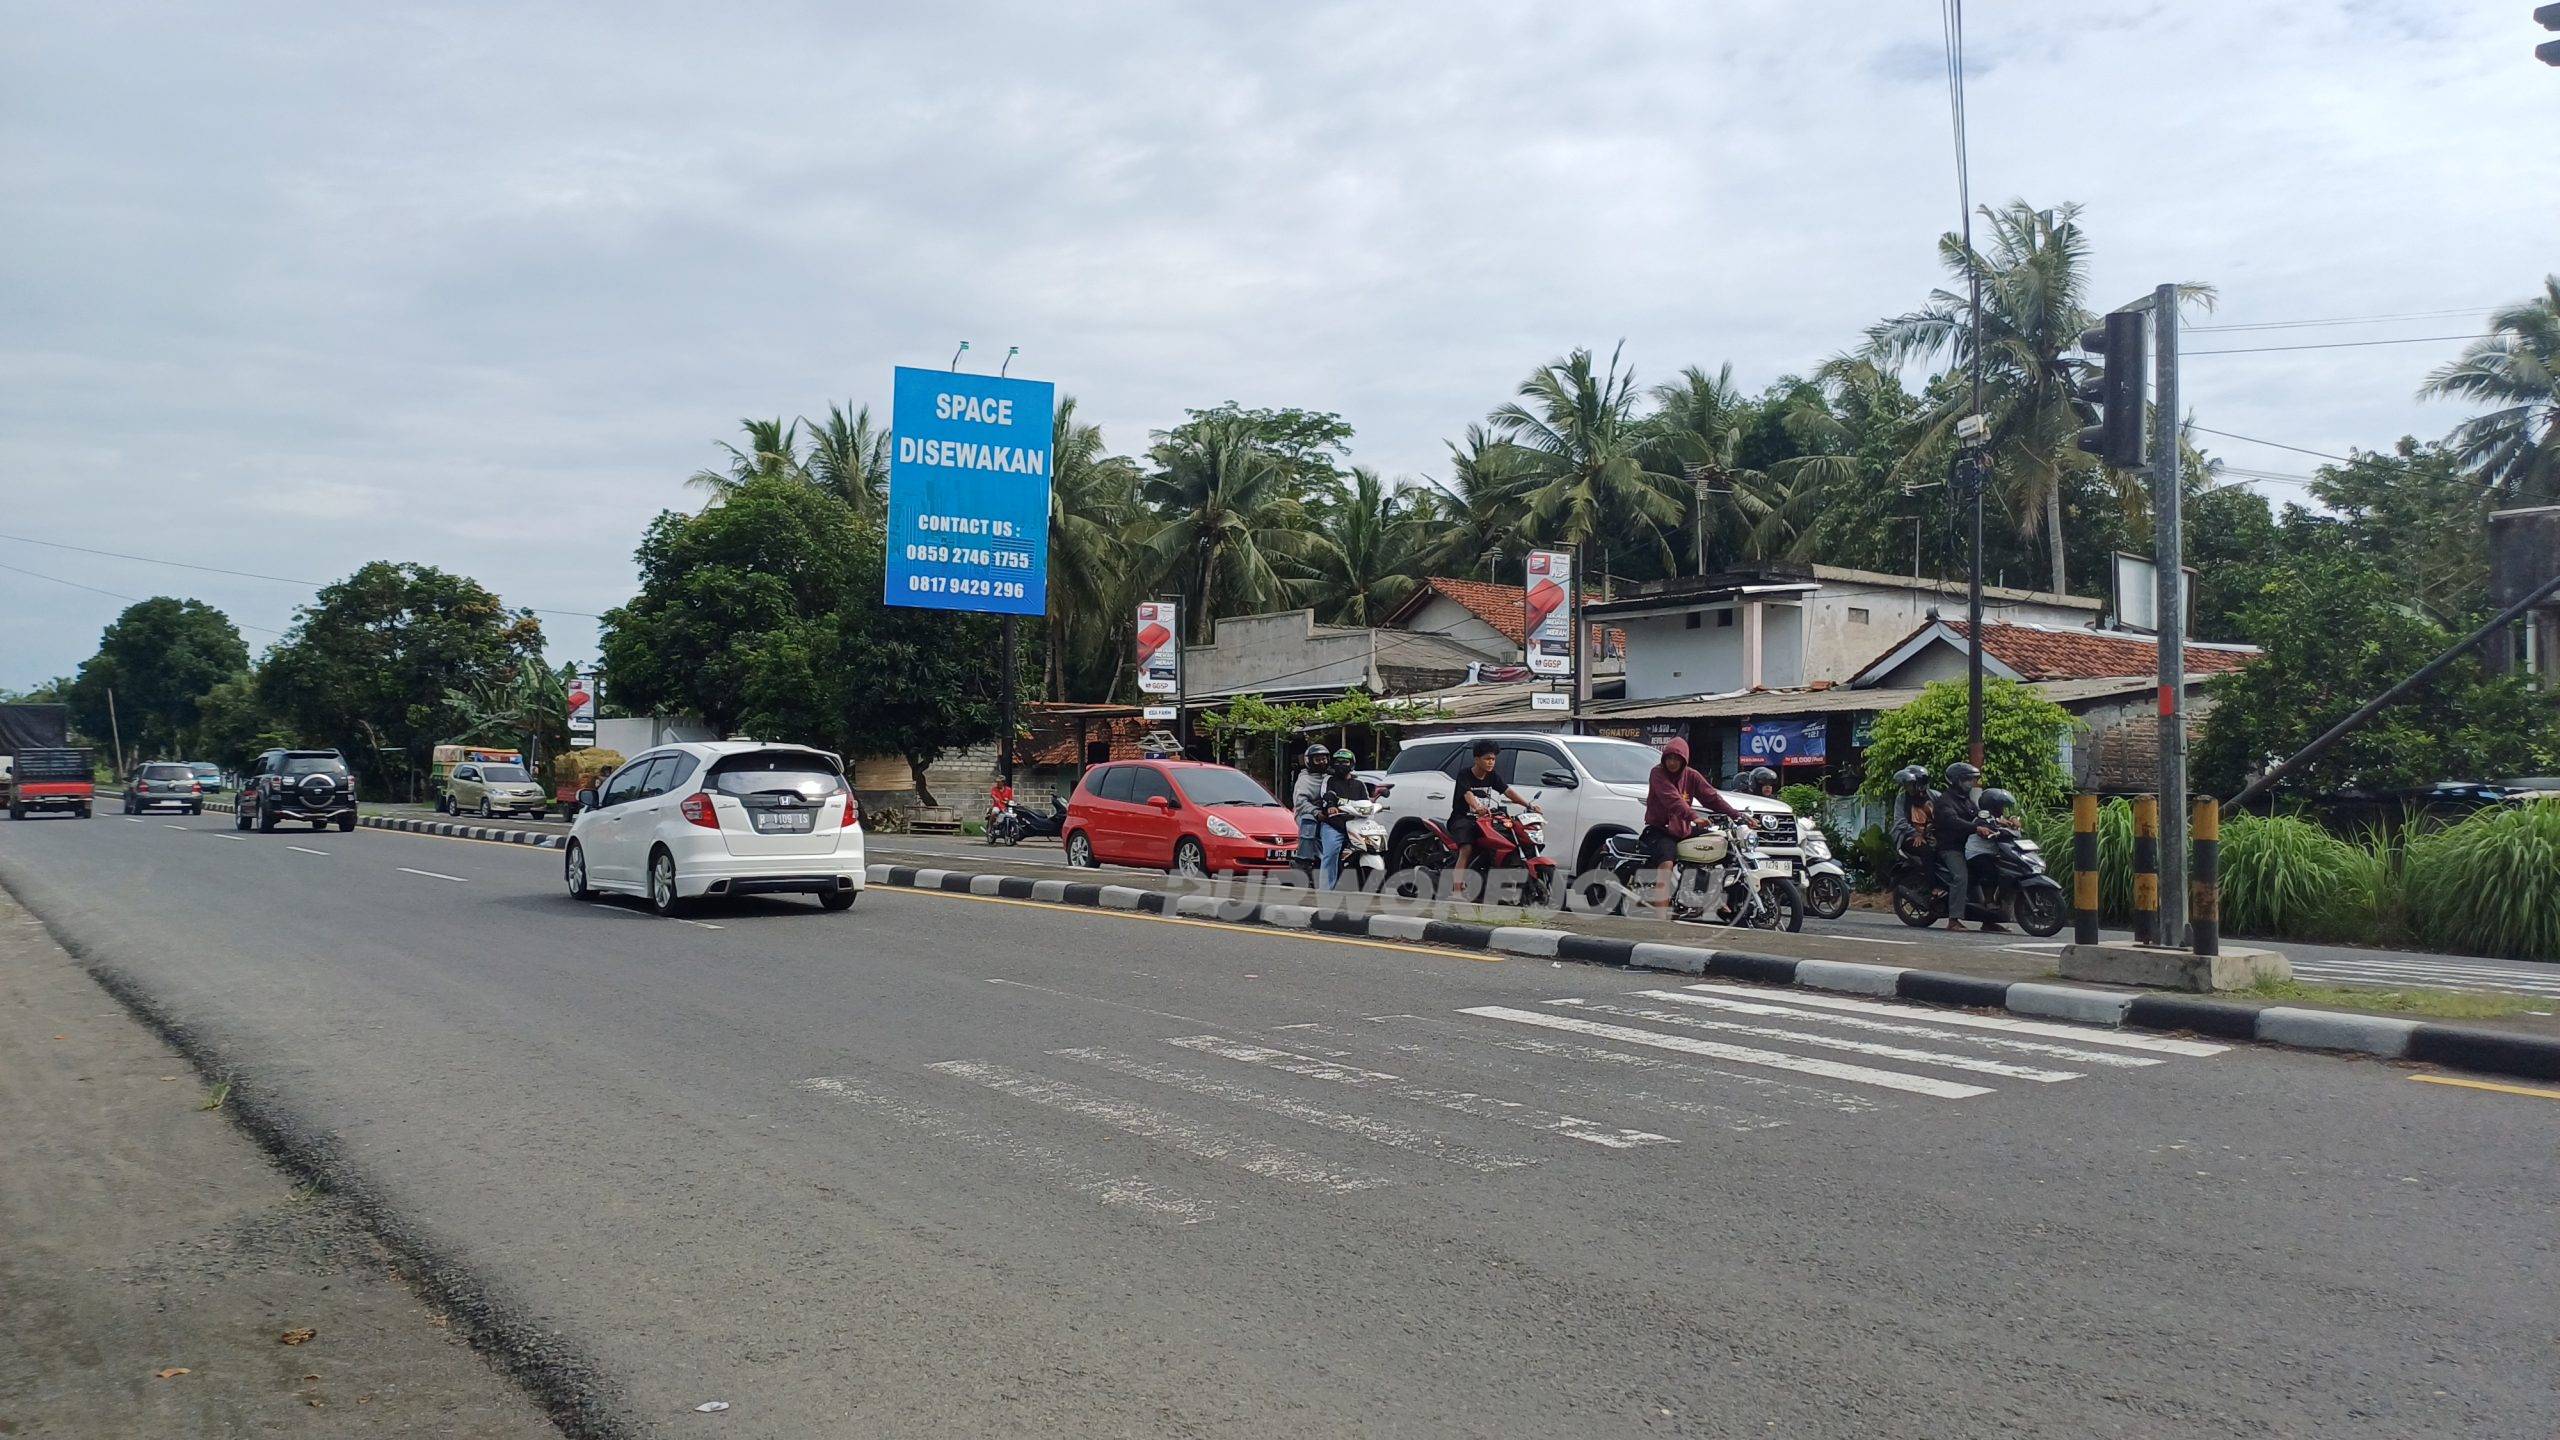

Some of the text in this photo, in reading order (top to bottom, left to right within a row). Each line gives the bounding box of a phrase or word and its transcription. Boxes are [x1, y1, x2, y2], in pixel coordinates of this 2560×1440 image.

[936, 393, 1013, 425] SPACE
[900, 437, 1044, 475] DISEWAKAN
[918, 514, 989, 535] CONTACT
[992, 521, 1012, 537] US
[906, 544, 1029, 568] 0859 2746 1755
[909, 575, 1024, 598] 0817 9429 296
[1542, 659, 1562, 668] GGSP
[1599, 728, 1641, 738] SIGNATURE
[1751, 734, 1787, 754] evo
